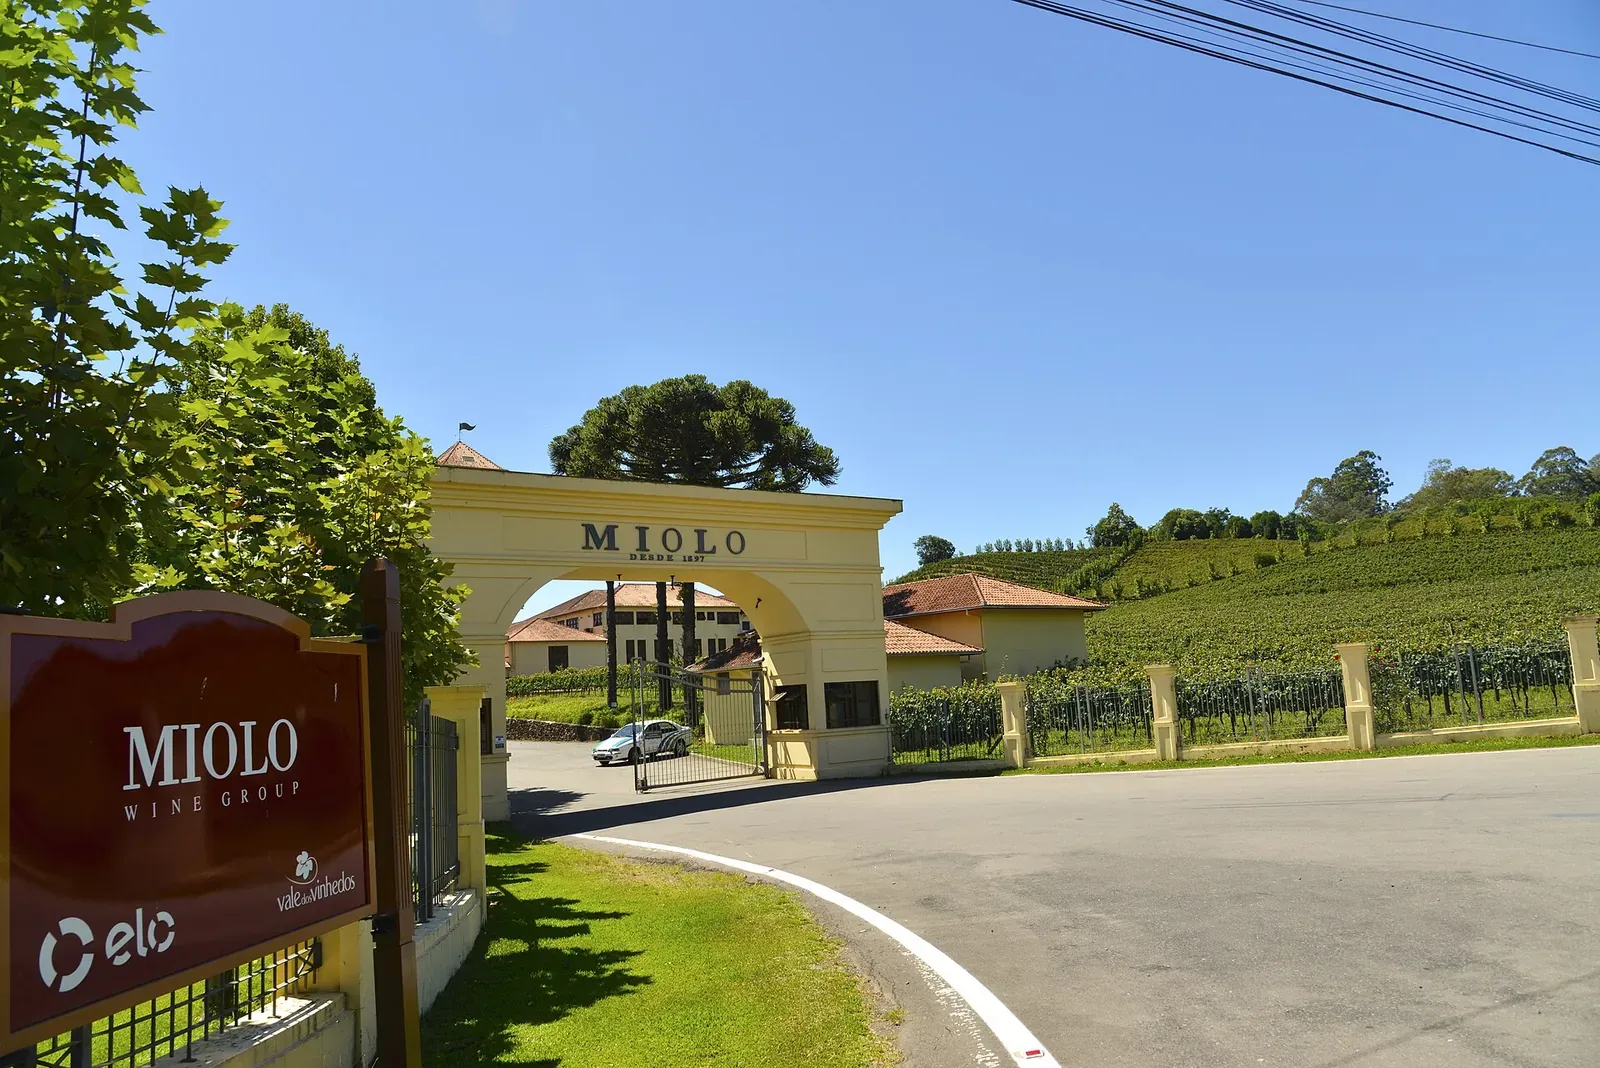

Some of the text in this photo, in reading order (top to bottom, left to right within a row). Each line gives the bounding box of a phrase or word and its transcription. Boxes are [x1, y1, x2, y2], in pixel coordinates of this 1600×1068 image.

[581, 523, 746, 555] MIOLO
[629, 553, 705, 563] DESDE 1897
[122, 718, 298, 791] MIOLO
[124, 781, 299, 822] WINE GROUP
[105, 907, 176, 966] elo
